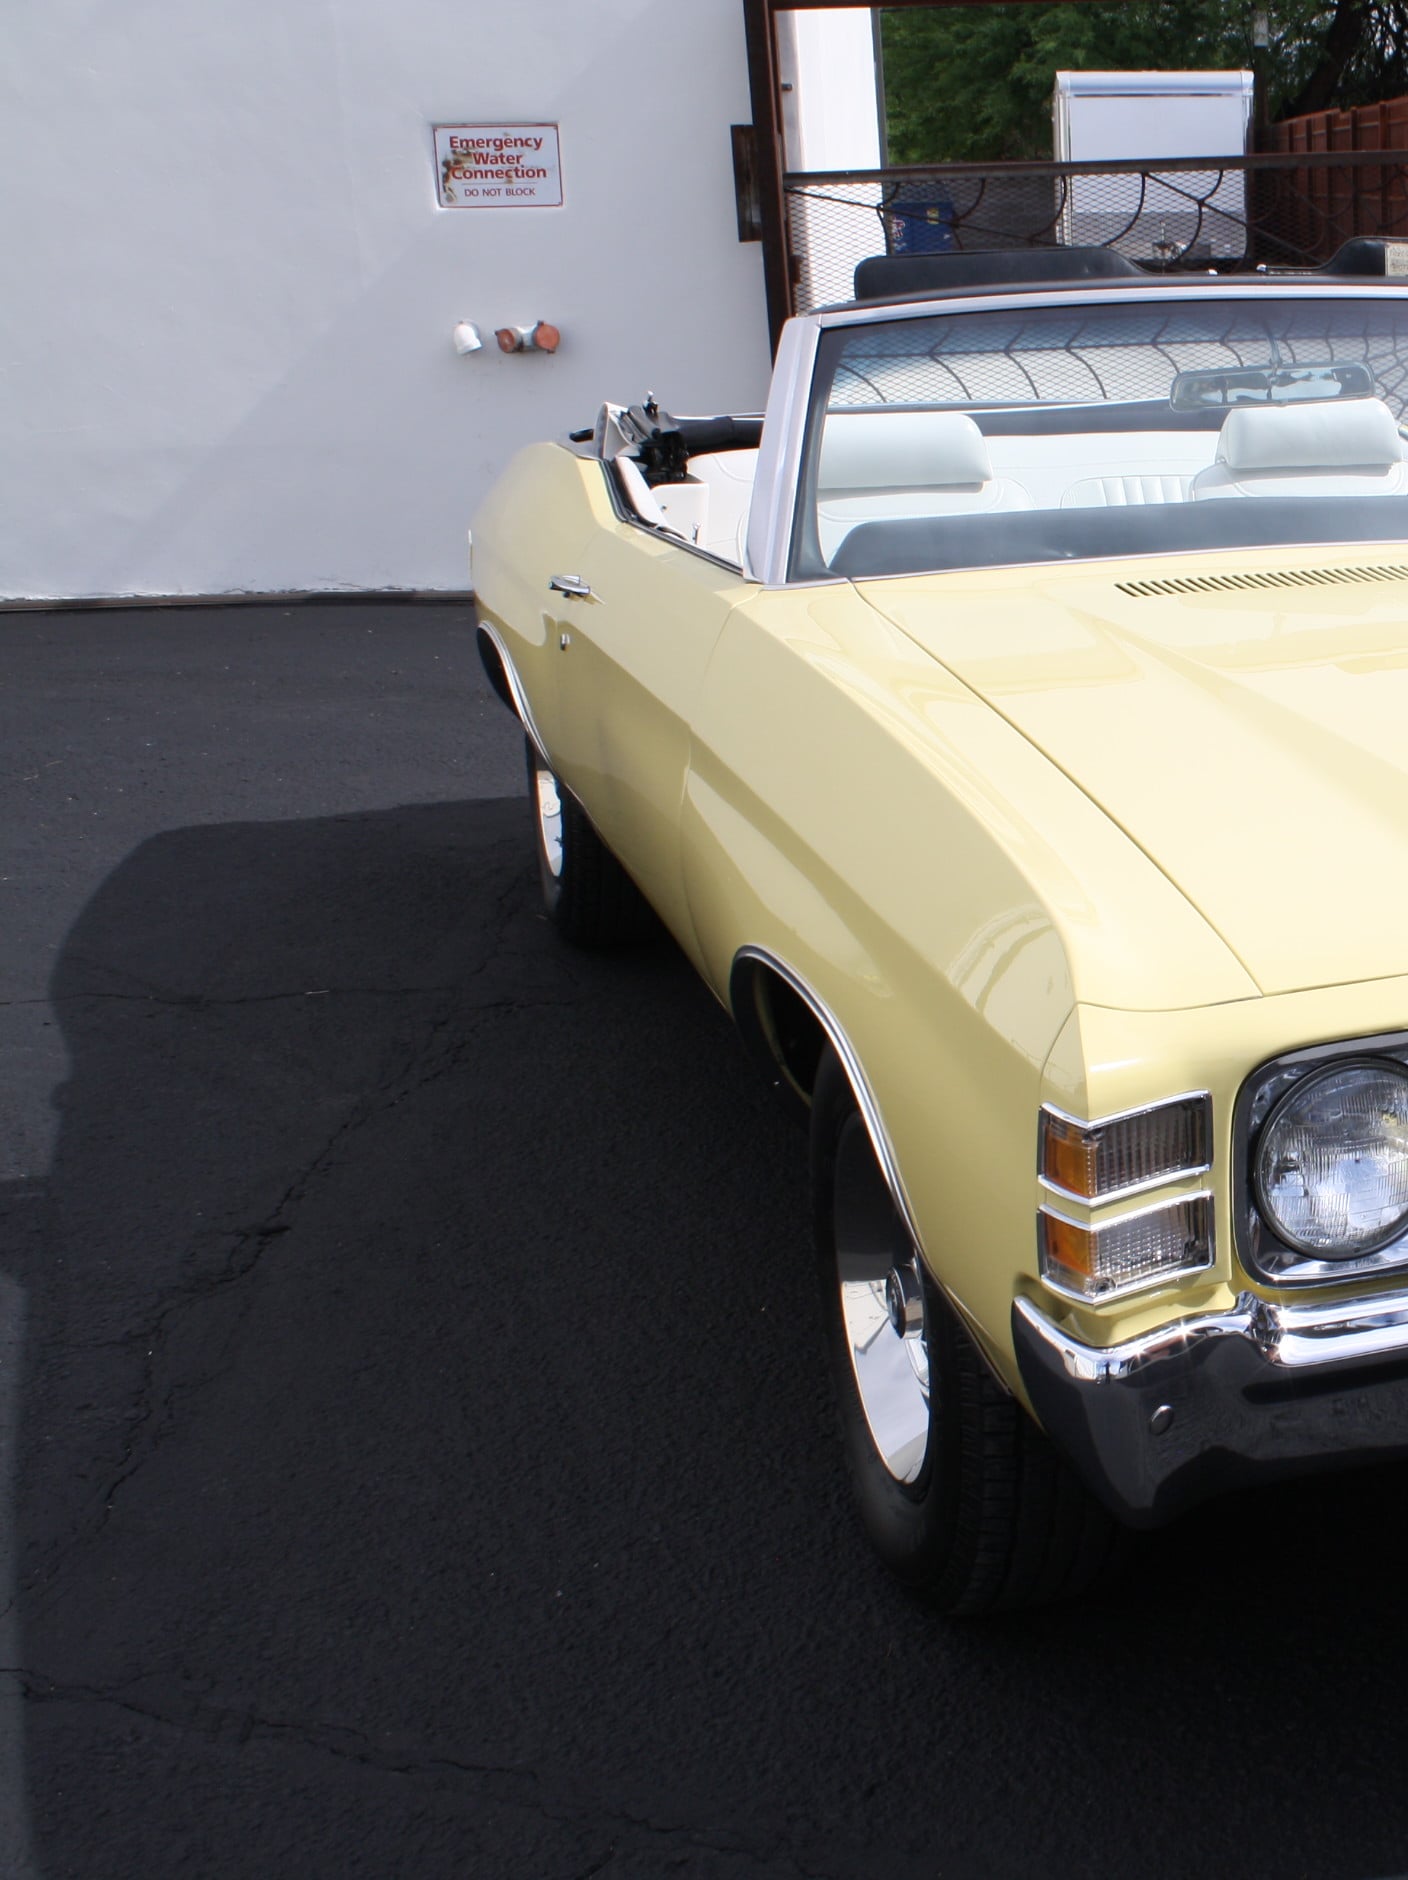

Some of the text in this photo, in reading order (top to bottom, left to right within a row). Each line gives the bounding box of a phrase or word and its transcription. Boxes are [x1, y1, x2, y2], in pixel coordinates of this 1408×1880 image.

[449, 136, 543, 151] Emergency
[472, 152, 523, 165] Water
[451, 165, 547, 179] Connection
[464, 188, 536, 197] DO NOT BLOCK
